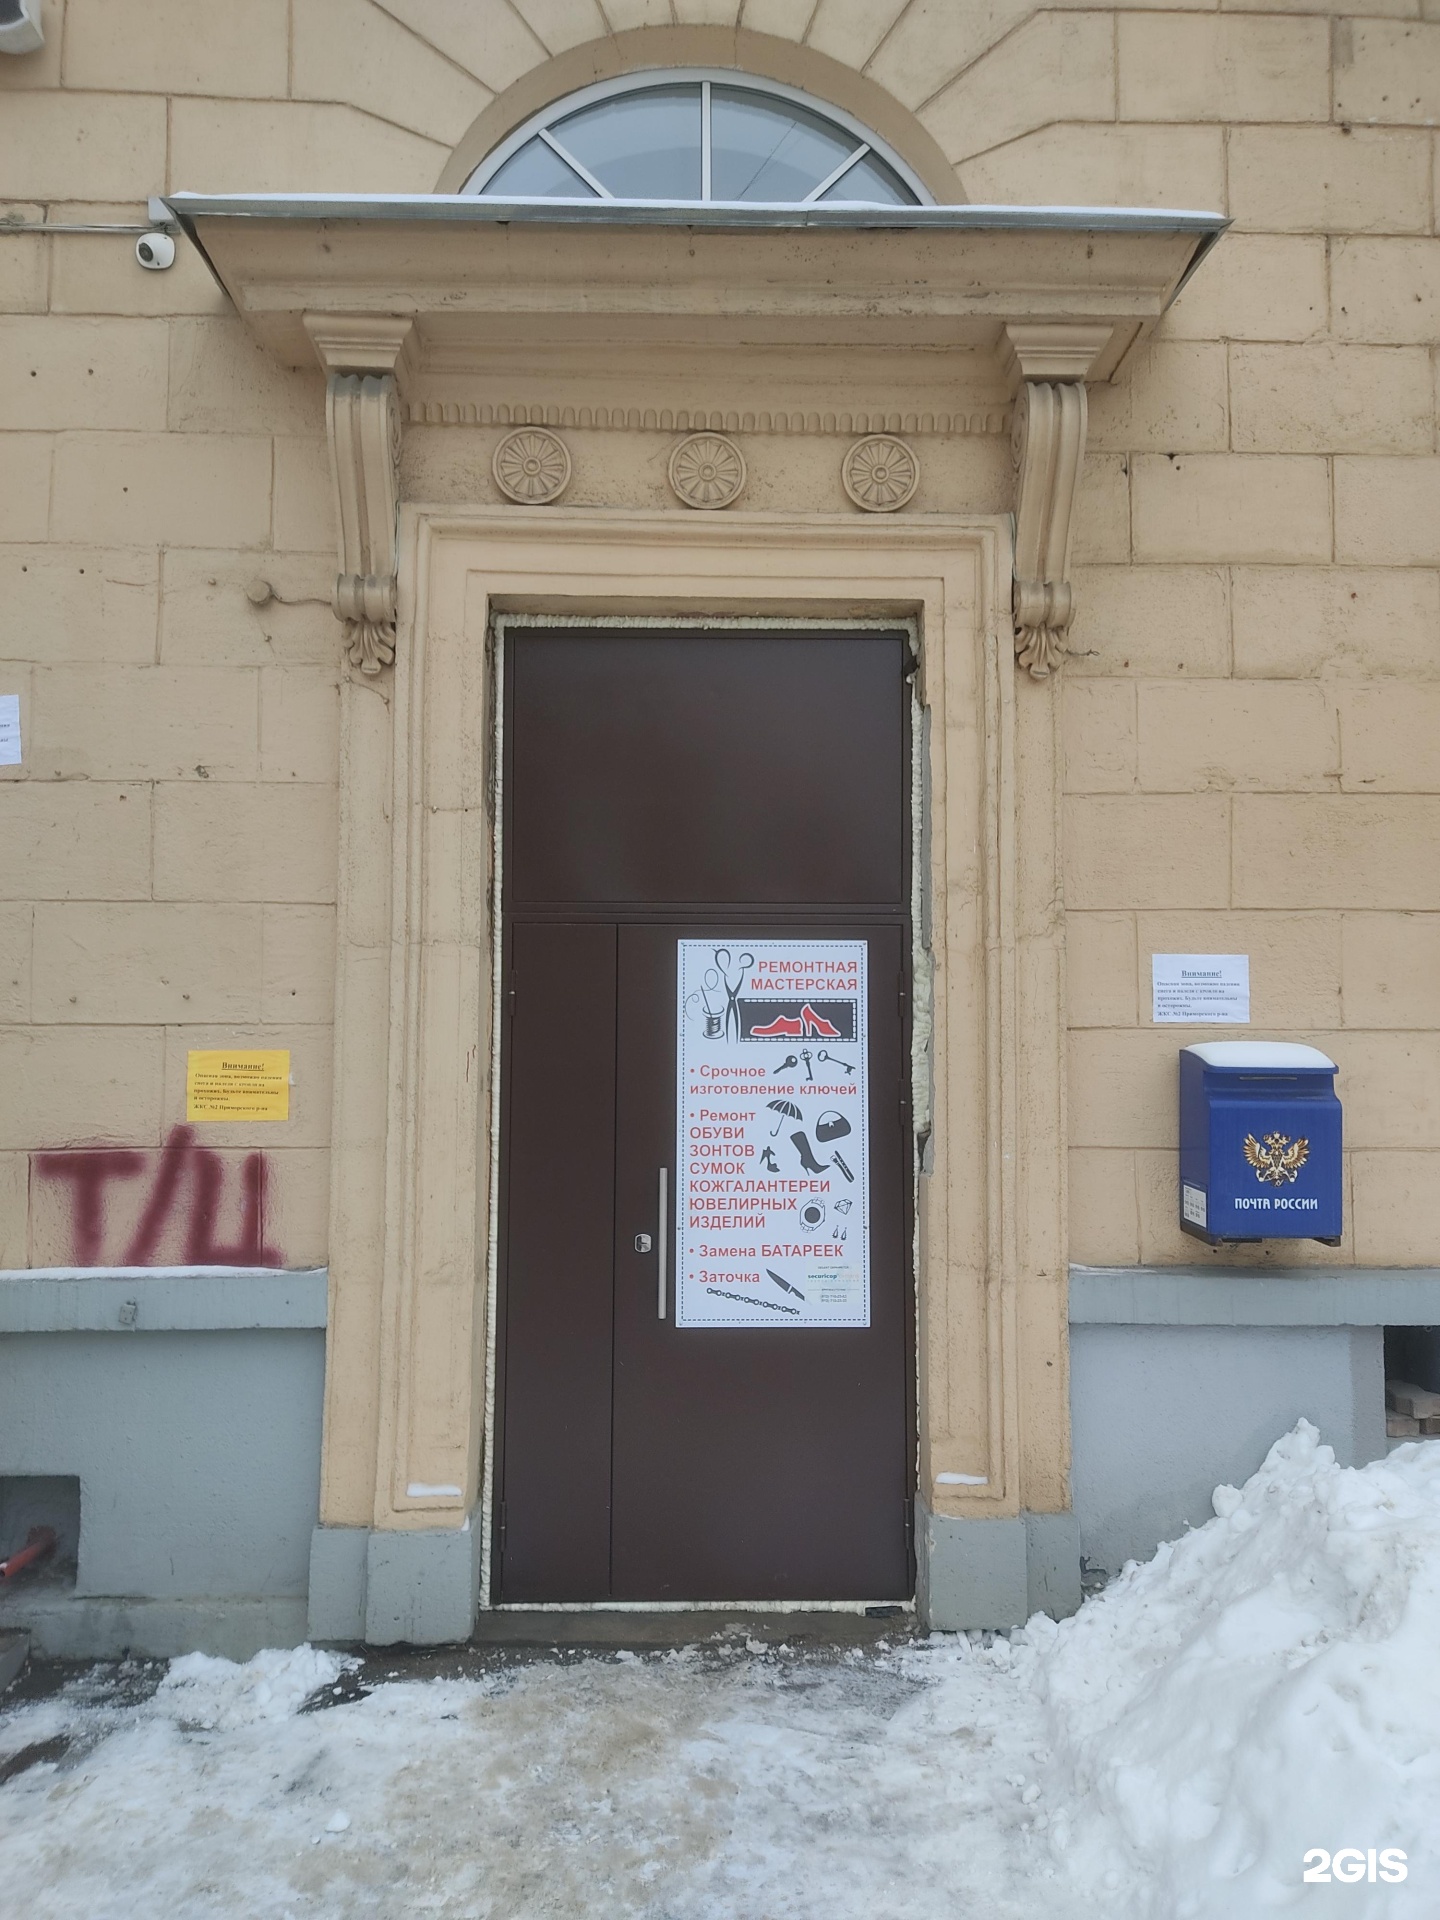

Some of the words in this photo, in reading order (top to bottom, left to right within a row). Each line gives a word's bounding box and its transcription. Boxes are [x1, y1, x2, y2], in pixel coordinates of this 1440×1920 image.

[758, 961, 858, 973] РЕМОНТНАЯ
[1181, 970, 1222, 979] Внимание!
[751, 978, 858, 991] МАСТЕРСКАЯ
[222, 1062, 265, 1071] Внимание!
[700, 1065, 766, 1080] Срочное
[690, 1085, 795, 1095] изготовление
[800, 1083, 857, 1095] ключей
[700, 1109, 757, 1121] Ремонт
[689, 1127, 745, 1139] ОБУВИ
[689, 1144, 755, 1157] ЗОНТОВ
[689, 1162, 745, 1175] СУМОК
[689, 1180, 831, 1193] КОЖГАЛАНТЕРЕИ
[689, 1197, 798, 1210] ЮВЕЛИРНЫХ
[1234, 1198, 1271, 1209] ПОЧТА
[1274, 1198, 1318, 1209] РОССИИ
[689, 1213, 765, 1230] ИЗДЕЛИЙ
[699, 1244, 756, 1257] Замена
[761, 1244, 844, 1257] БАТАРЕЕК
[699, 1270, 760, 1283] Заточка
